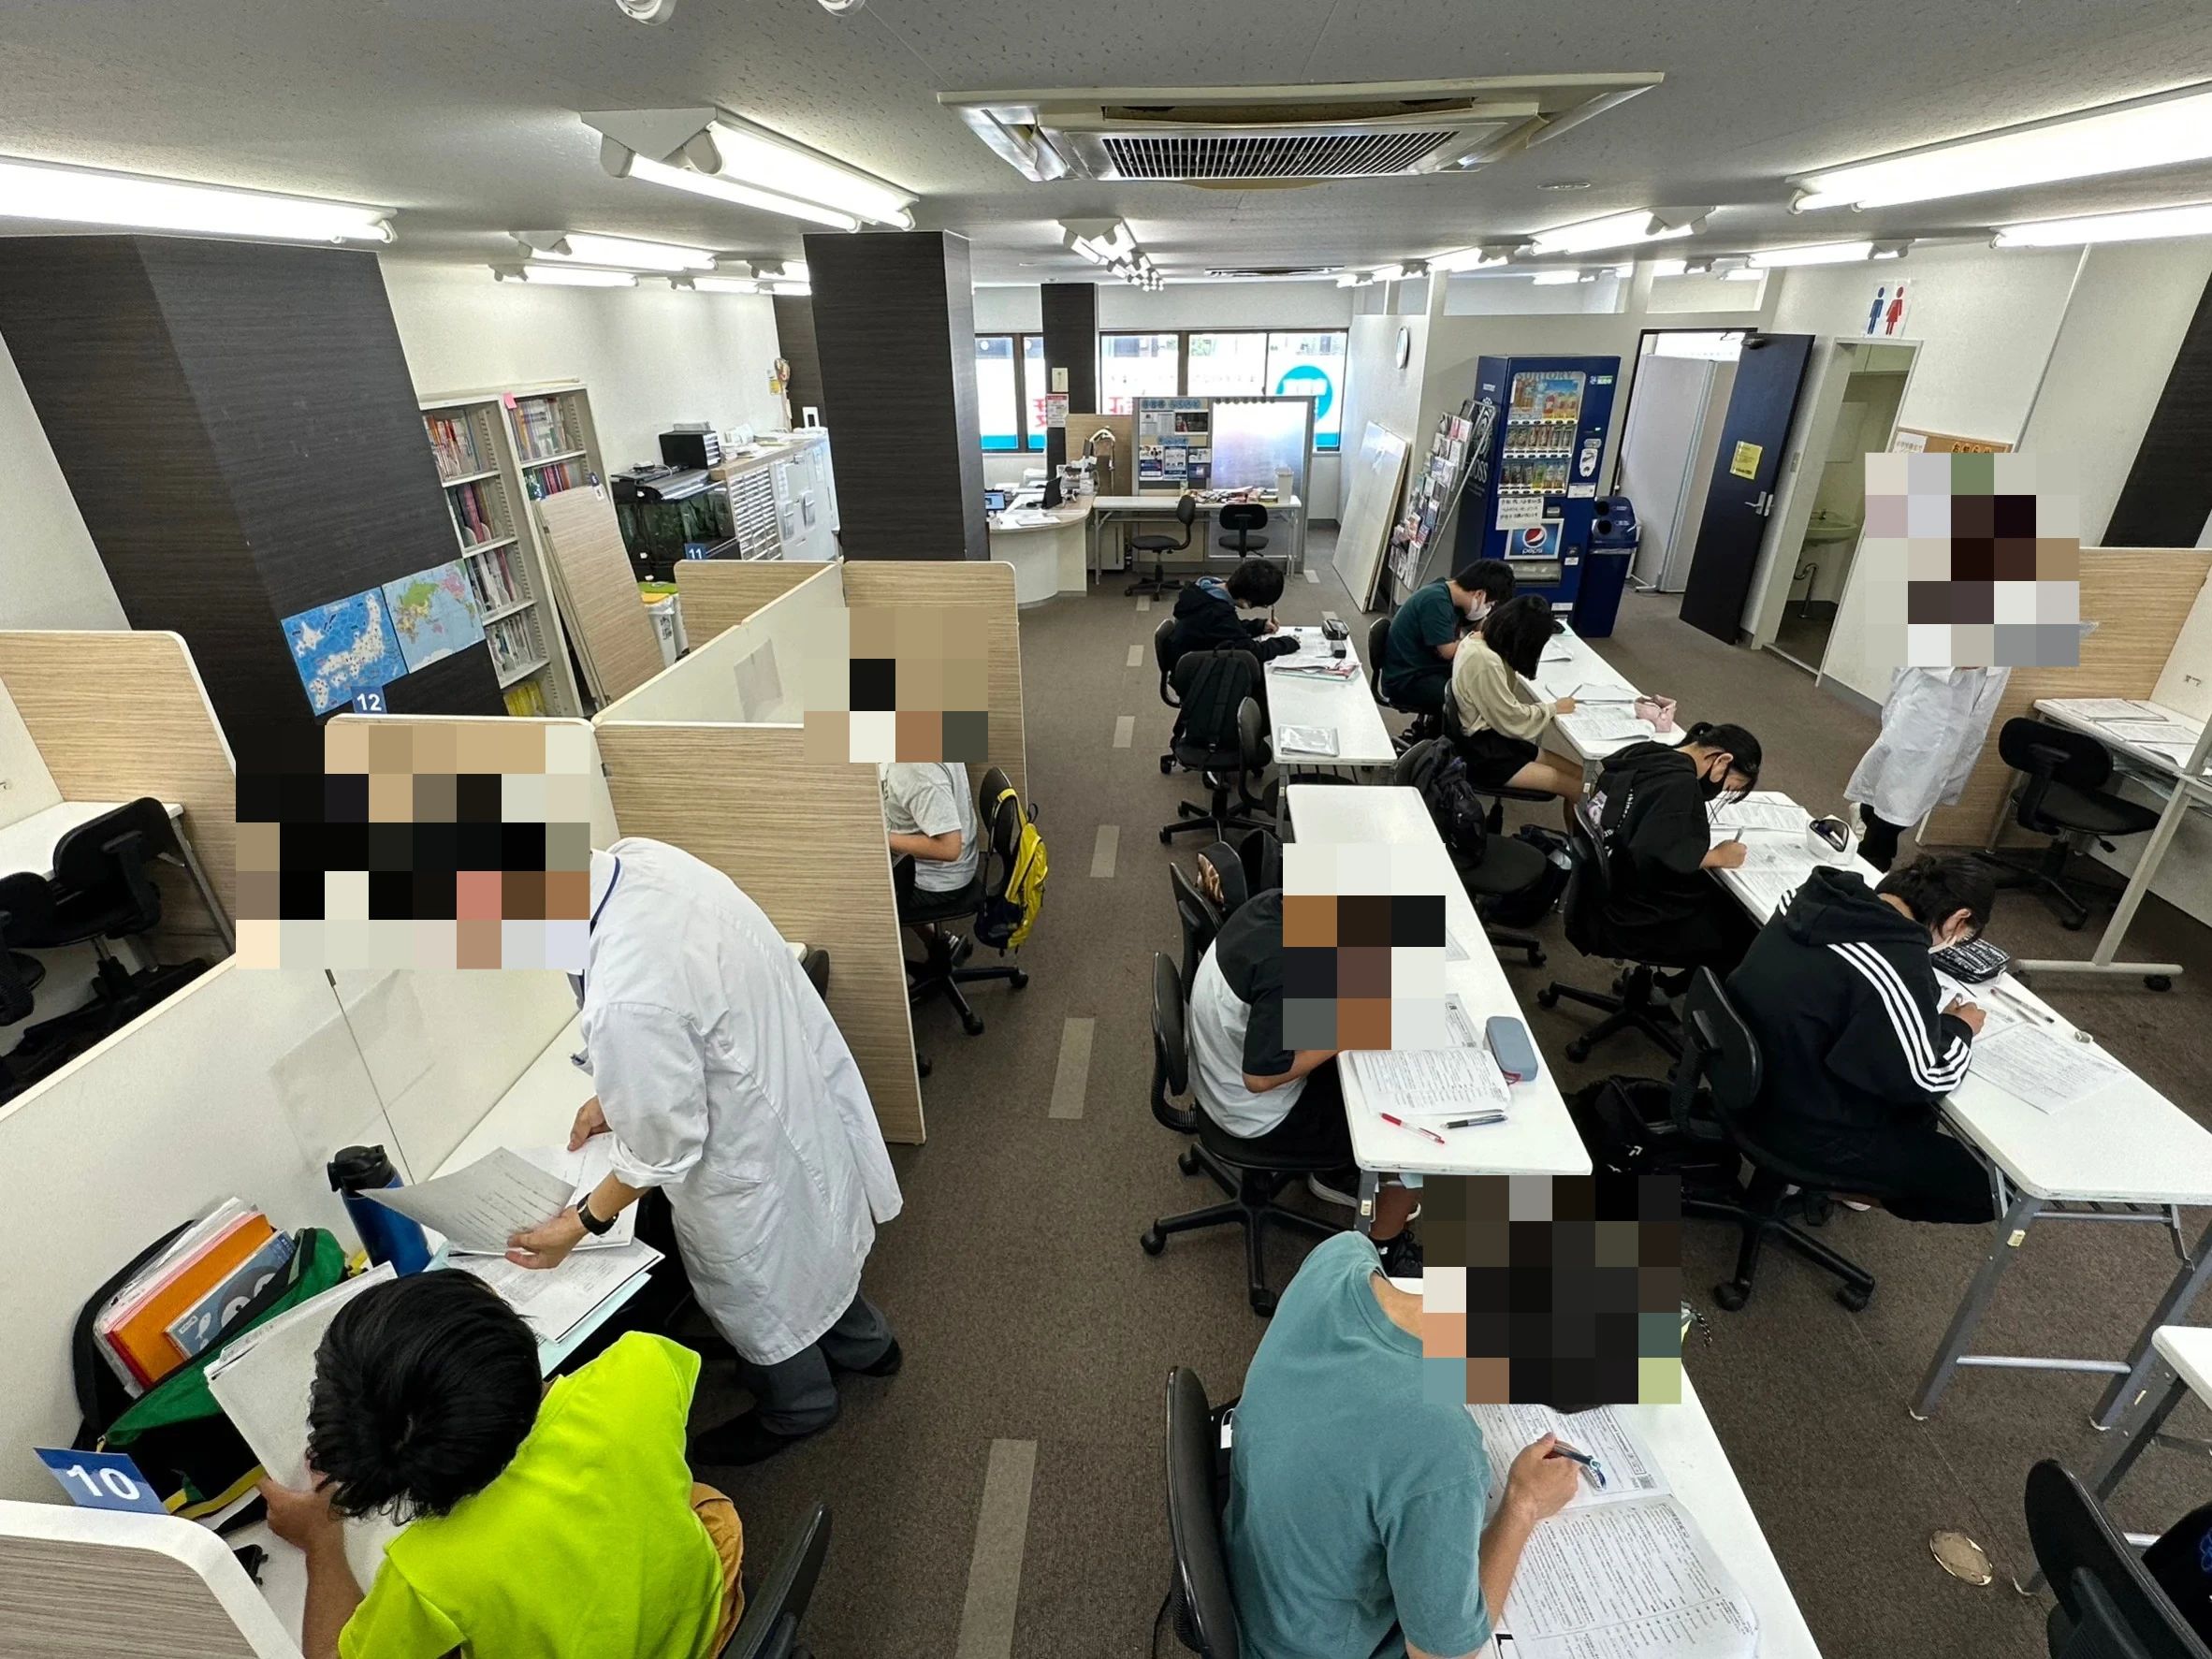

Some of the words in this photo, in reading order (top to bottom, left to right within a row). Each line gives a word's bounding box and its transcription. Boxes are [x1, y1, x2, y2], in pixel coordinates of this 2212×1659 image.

[688, 547, 702, 560] 11
[357, 692, 383, 711] 12
[65, 1463, 140, 1500] 10
